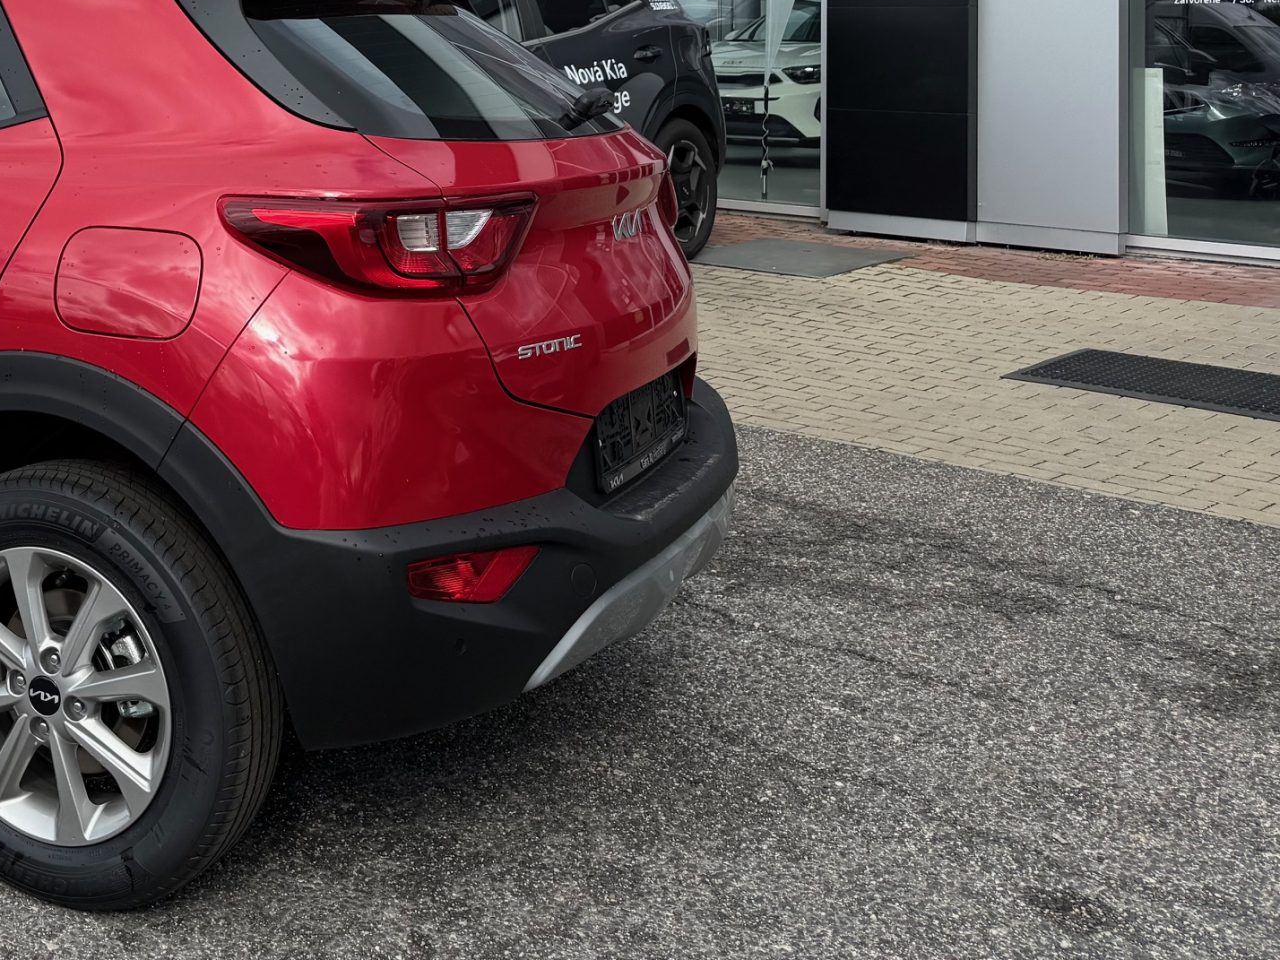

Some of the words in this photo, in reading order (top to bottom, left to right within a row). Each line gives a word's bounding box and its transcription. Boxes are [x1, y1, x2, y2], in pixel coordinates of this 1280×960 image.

[564, 61, 605, 85] Nová
[602, 58, 628, 80] Kia
[612, 208, 642, 241] KIA
[518, 334, 583, 360] STONIC
[109, 543, 167, 600] PRIMACY
